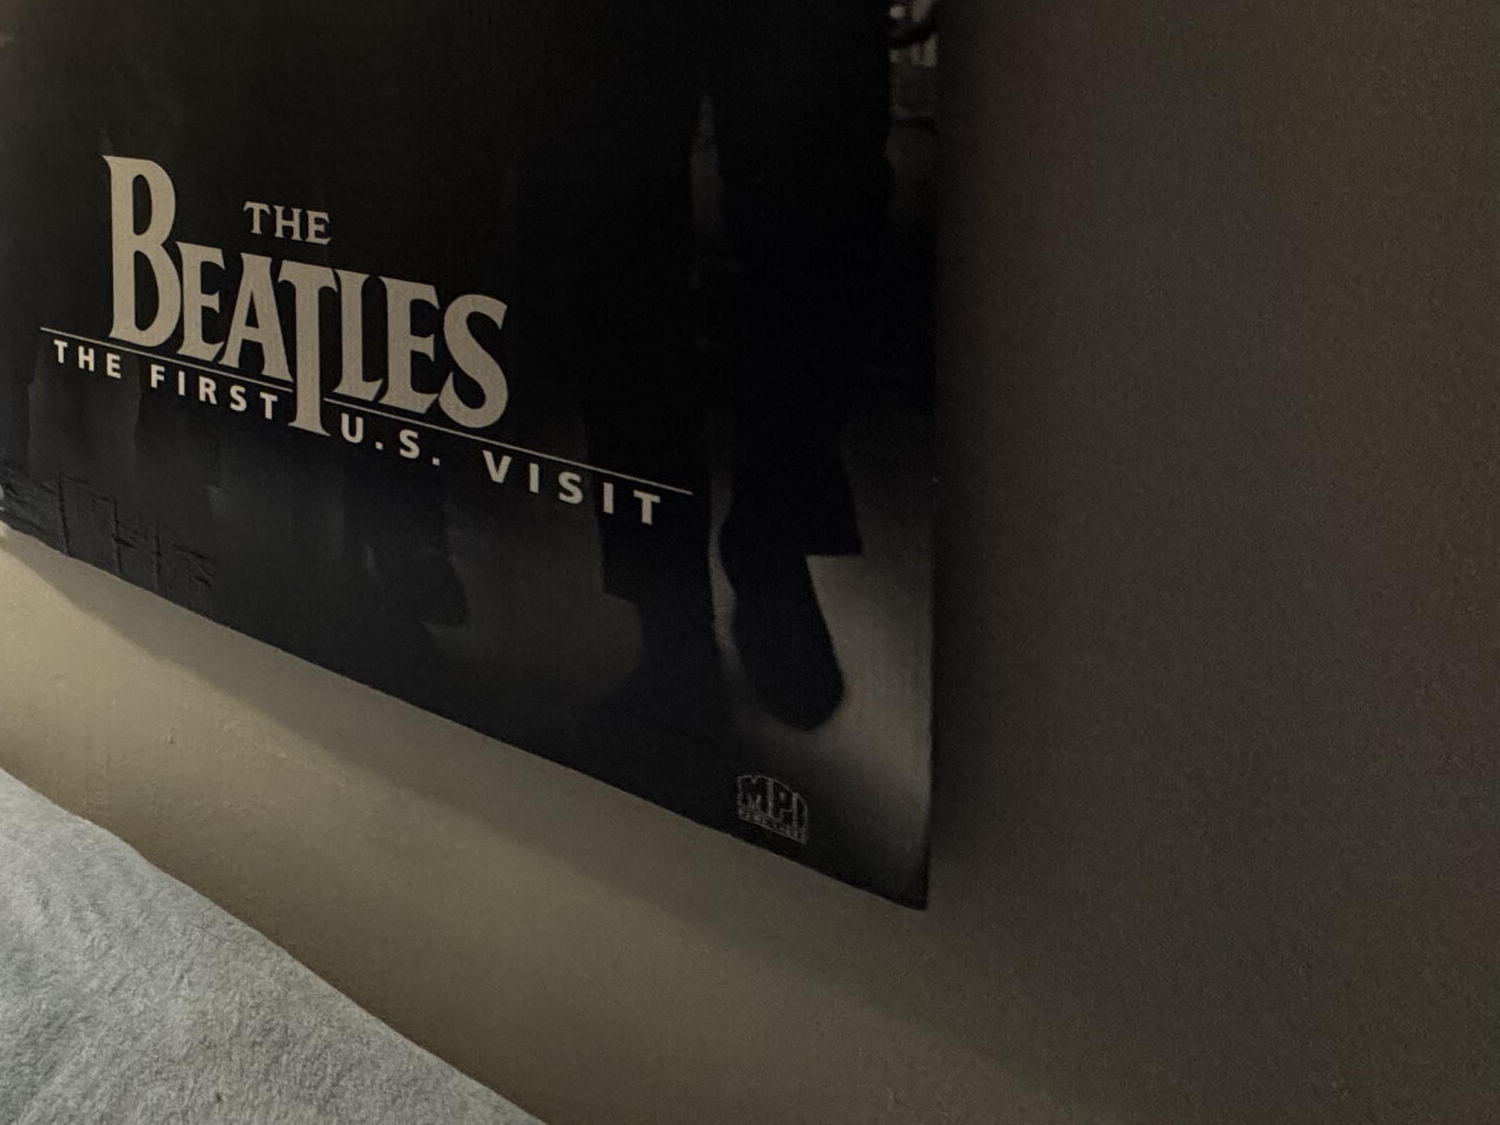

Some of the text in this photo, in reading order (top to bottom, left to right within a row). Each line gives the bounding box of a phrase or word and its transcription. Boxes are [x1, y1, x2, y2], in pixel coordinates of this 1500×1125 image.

[102, 154, 509, 438] BEATLES
[242, 201, 333, 247] THE
[53, 338, 662, 526] THE FIRST U.S. VISIT
